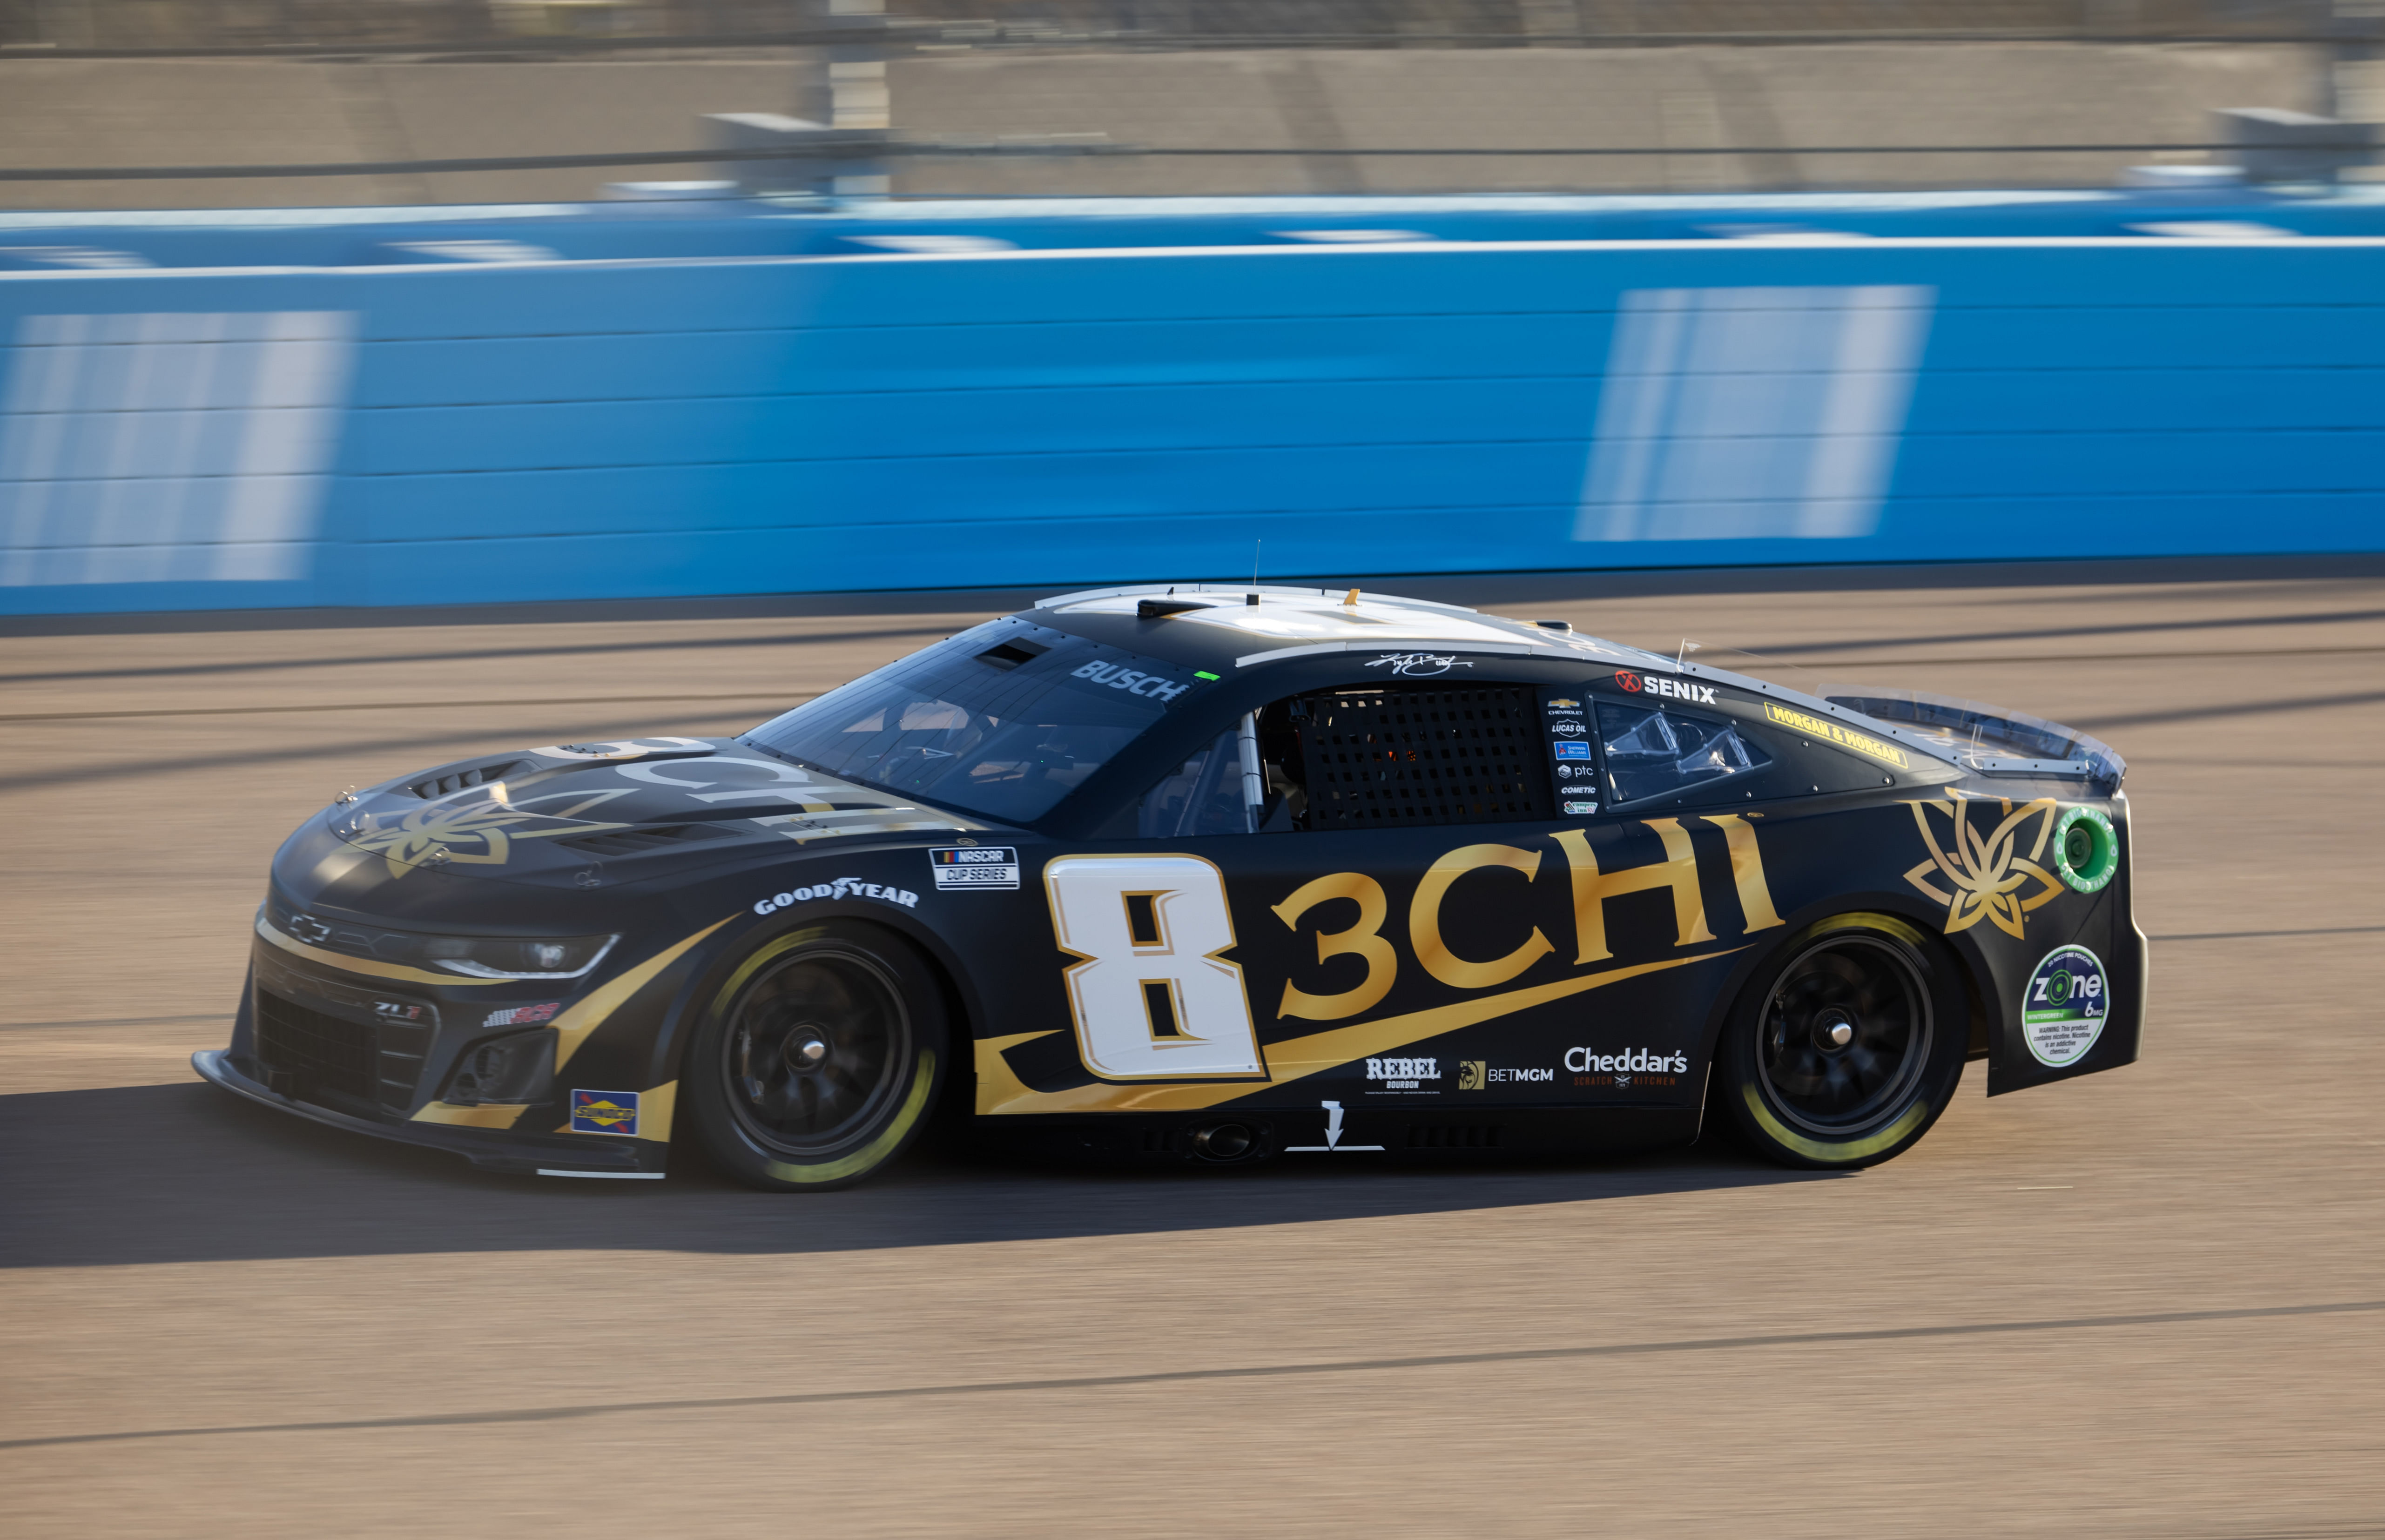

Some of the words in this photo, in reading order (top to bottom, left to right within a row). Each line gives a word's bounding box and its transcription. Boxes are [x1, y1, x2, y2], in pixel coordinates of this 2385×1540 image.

[1070, 659, 1190, 703] BUSCH
[1644, 676, 1717, 705] SENIX
[1772, 706, 1830, 737] MORGAN
[1832, 727, 1844, 741] &
[1844, 732, 1900, 763] MORGAN
[1575, 765, 1594, 778] ptc
[2068, 808, 2113, 834] BIOTHANO
[958, 850, 1004, 862] NASCAR
[946, 869, 968, 881] CUP
[969, 868, 1007, 880] SERIES
[754, 878, 919, 915] GOODYEAR
[1271, 814, 1785, 1021] 3CHI
[1043, 852, 1271, 1083] 8
[2053, 952, 2075, 962] NICOTINE
[2074, 952, 2094, 967] POUCHES
[2034, 974, 2102, 1006] zone
[2028, 1012, 2064, 1021] WINTERGREEN
[1365, 1057, 1442, 1080] REBEL
[1564, 1047, 1688, 1074] Cheddar's
[1386, 1081, 1419, 1089] BOURBON
[1488, 1069, 1554, 1082] BETMGM
[1574, 1076, 1612, 1086] SCRATCH
[1633, 1076, 1676, 1086] KITCHEN
